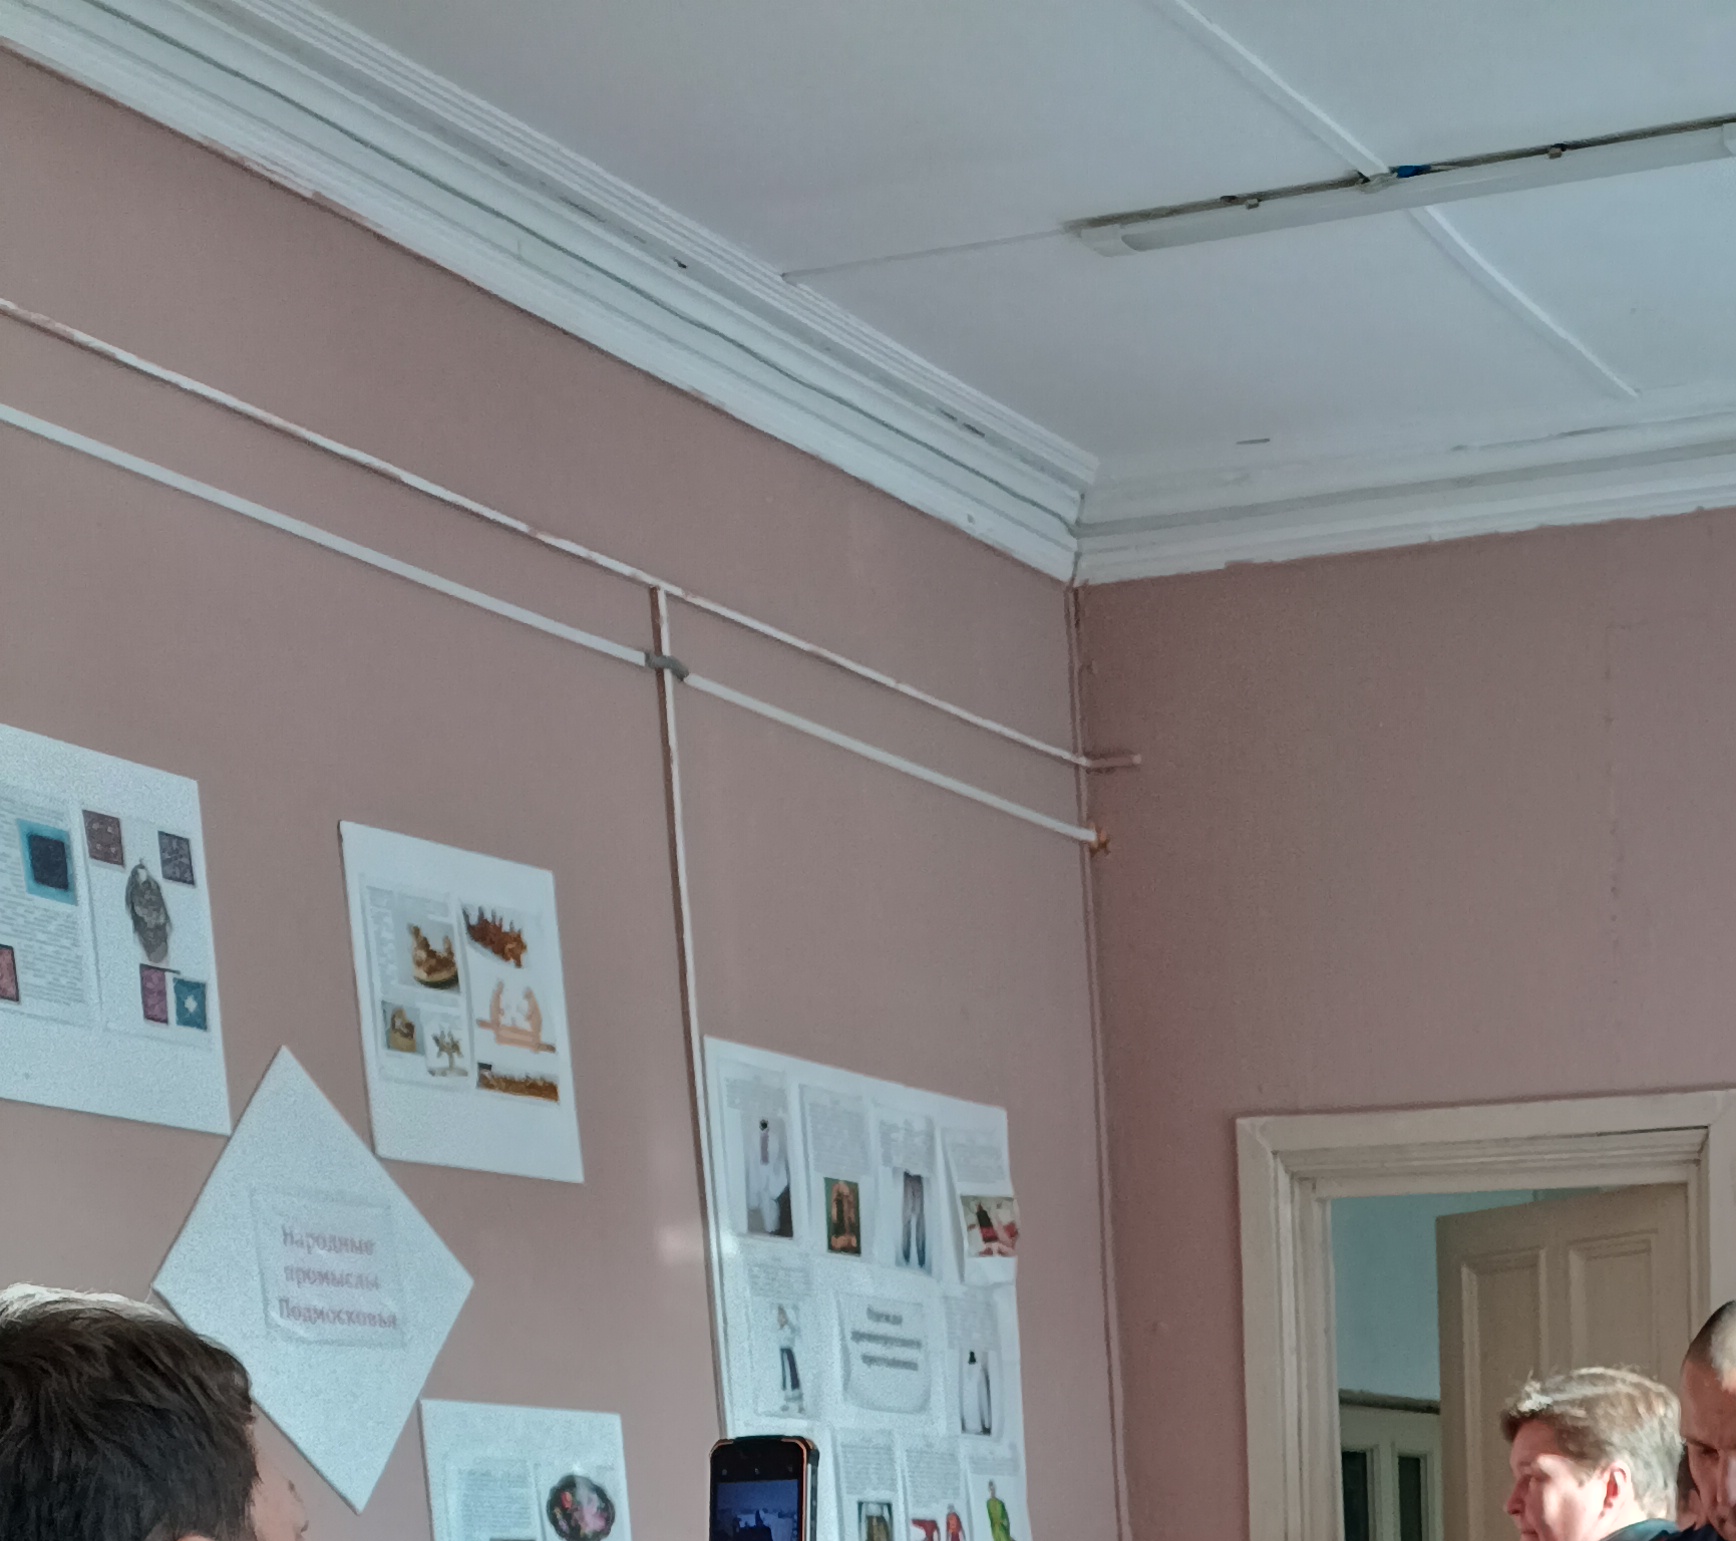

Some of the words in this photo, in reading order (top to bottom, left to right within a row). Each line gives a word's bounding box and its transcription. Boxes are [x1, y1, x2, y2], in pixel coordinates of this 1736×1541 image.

[282, 1225, 376, 1256] Народные
[284, 1265, 381, 1291] промыслы
[278, 1297, 398, 1329] Подмосковья
